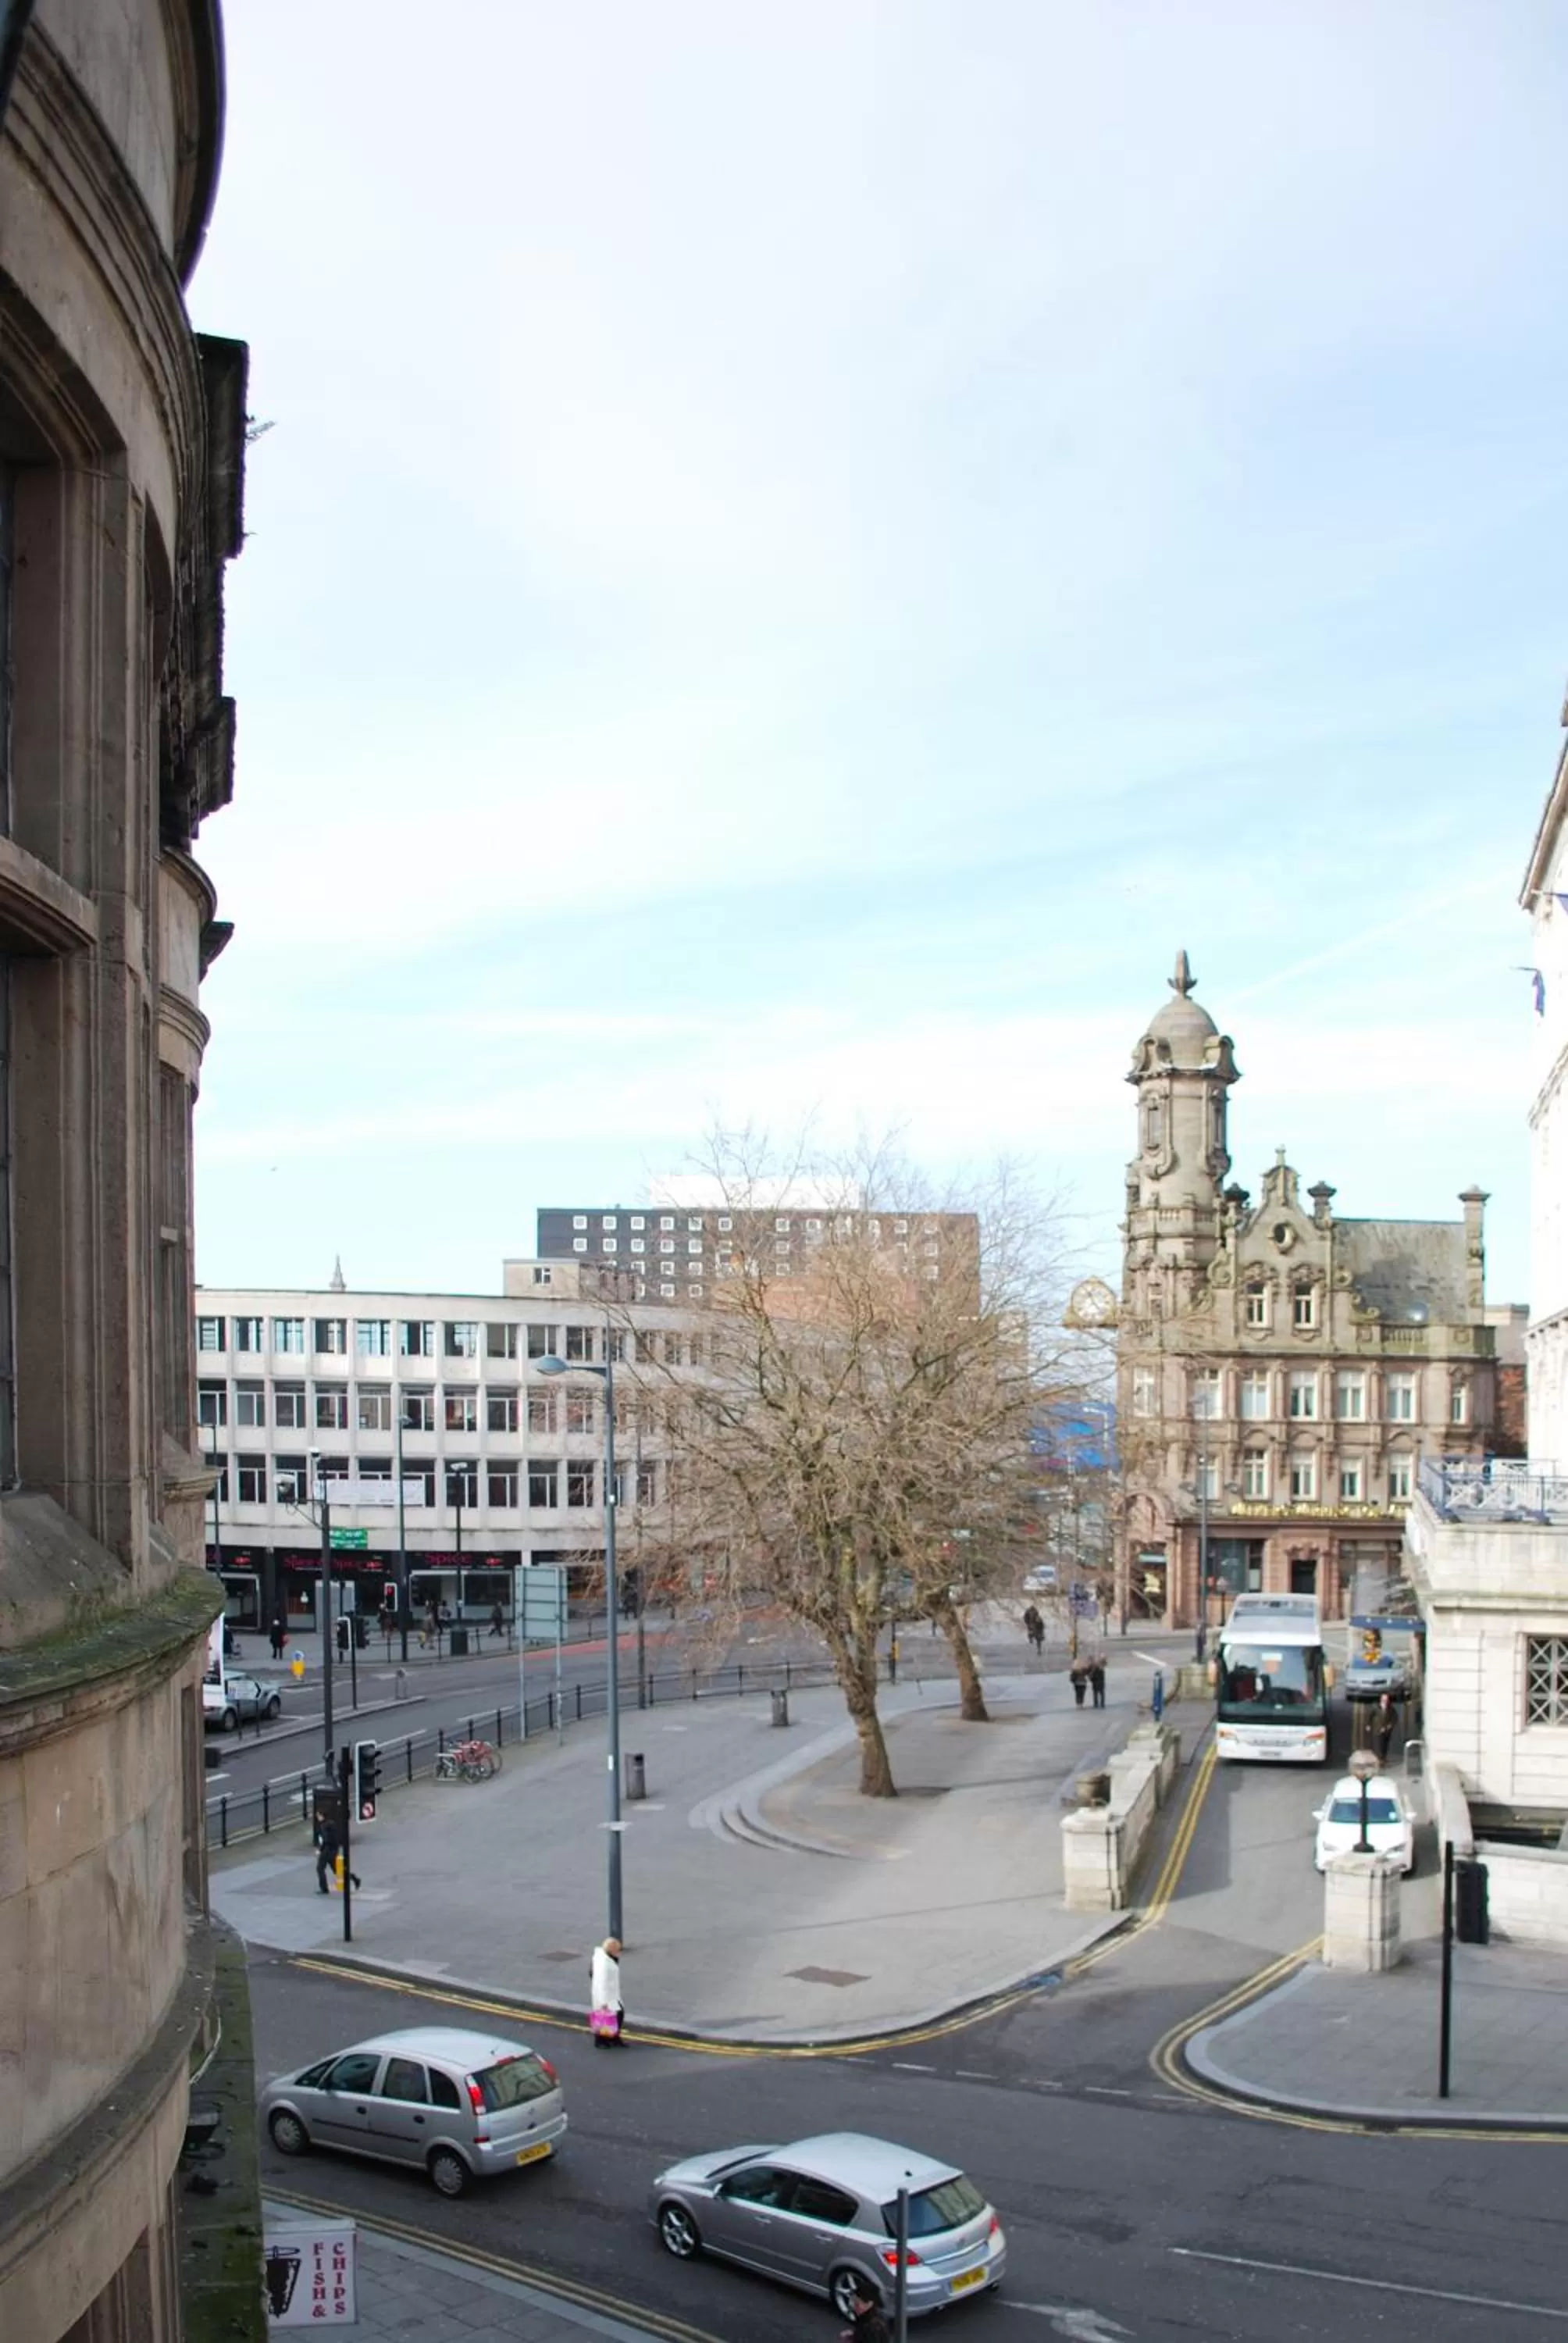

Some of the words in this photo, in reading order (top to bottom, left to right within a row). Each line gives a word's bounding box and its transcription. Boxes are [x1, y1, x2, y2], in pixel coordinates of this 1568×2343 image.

[312, 2241, 326, 2300] FISH
[333, 2242, 346, 2314] CHIPS
[312, 2304, 327, 2318] &
